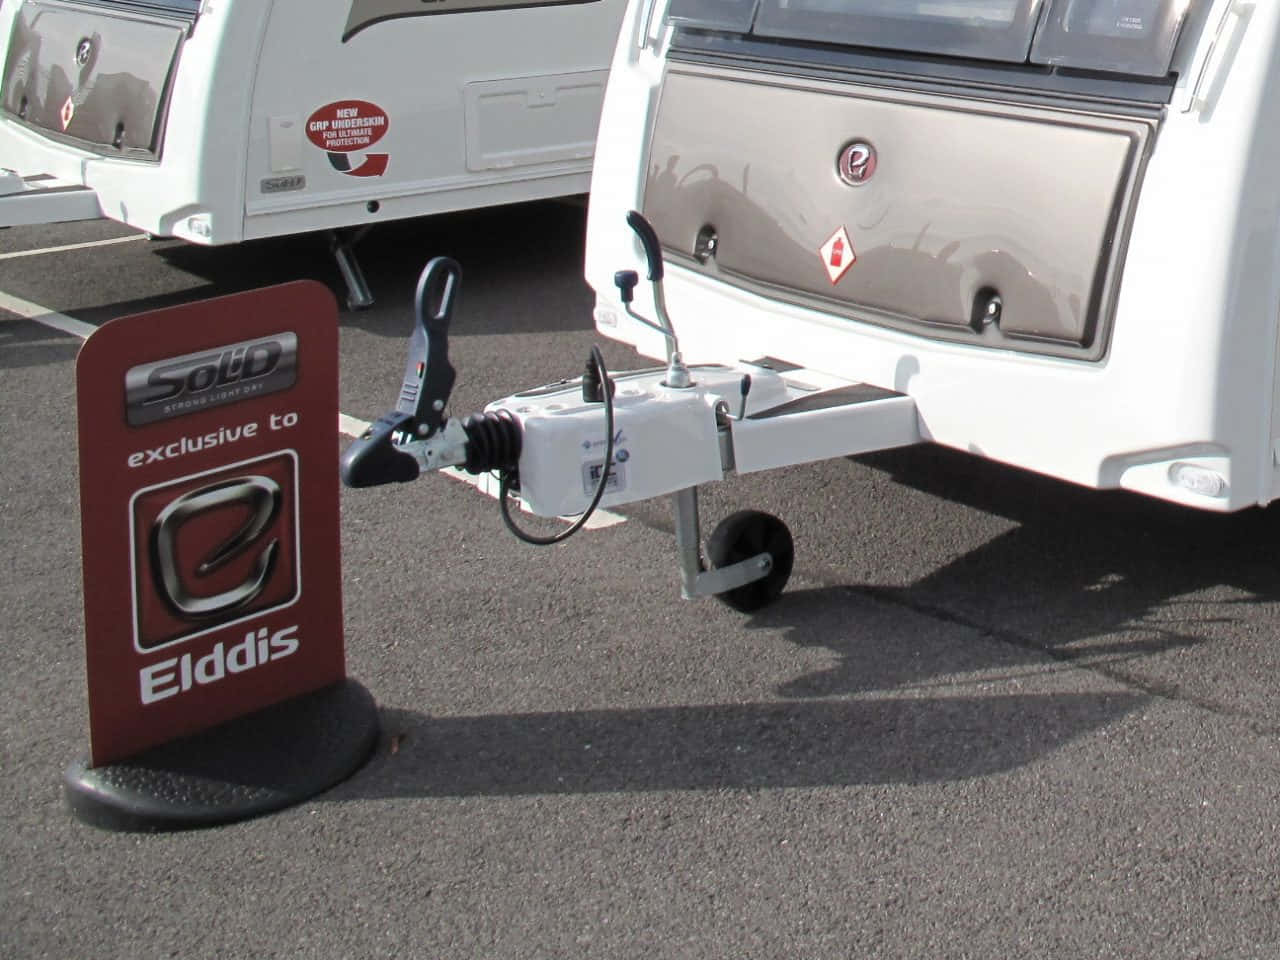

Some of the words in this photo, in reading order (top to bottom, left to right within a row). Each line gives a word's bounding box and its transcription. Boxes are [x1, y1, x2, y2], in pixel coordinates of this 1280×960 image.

[336, 107, 359, 119] NEW
[310, 120, 330, 132] GRP
[332, 116, 385, 130] UNDERSKIN
[323, 130, 337, 139] FOR
[326, 136, 370, 148] PROTECTION
[163, 394, 208, 414] STRONG
[210, 388, 241, 402] LIGHT
[243, 382, 265, 394] DRY
[127, 422, 258, 468] exclusive
[269, 412, 298, 431] to
[139, 625, 299, 705] Elddis
